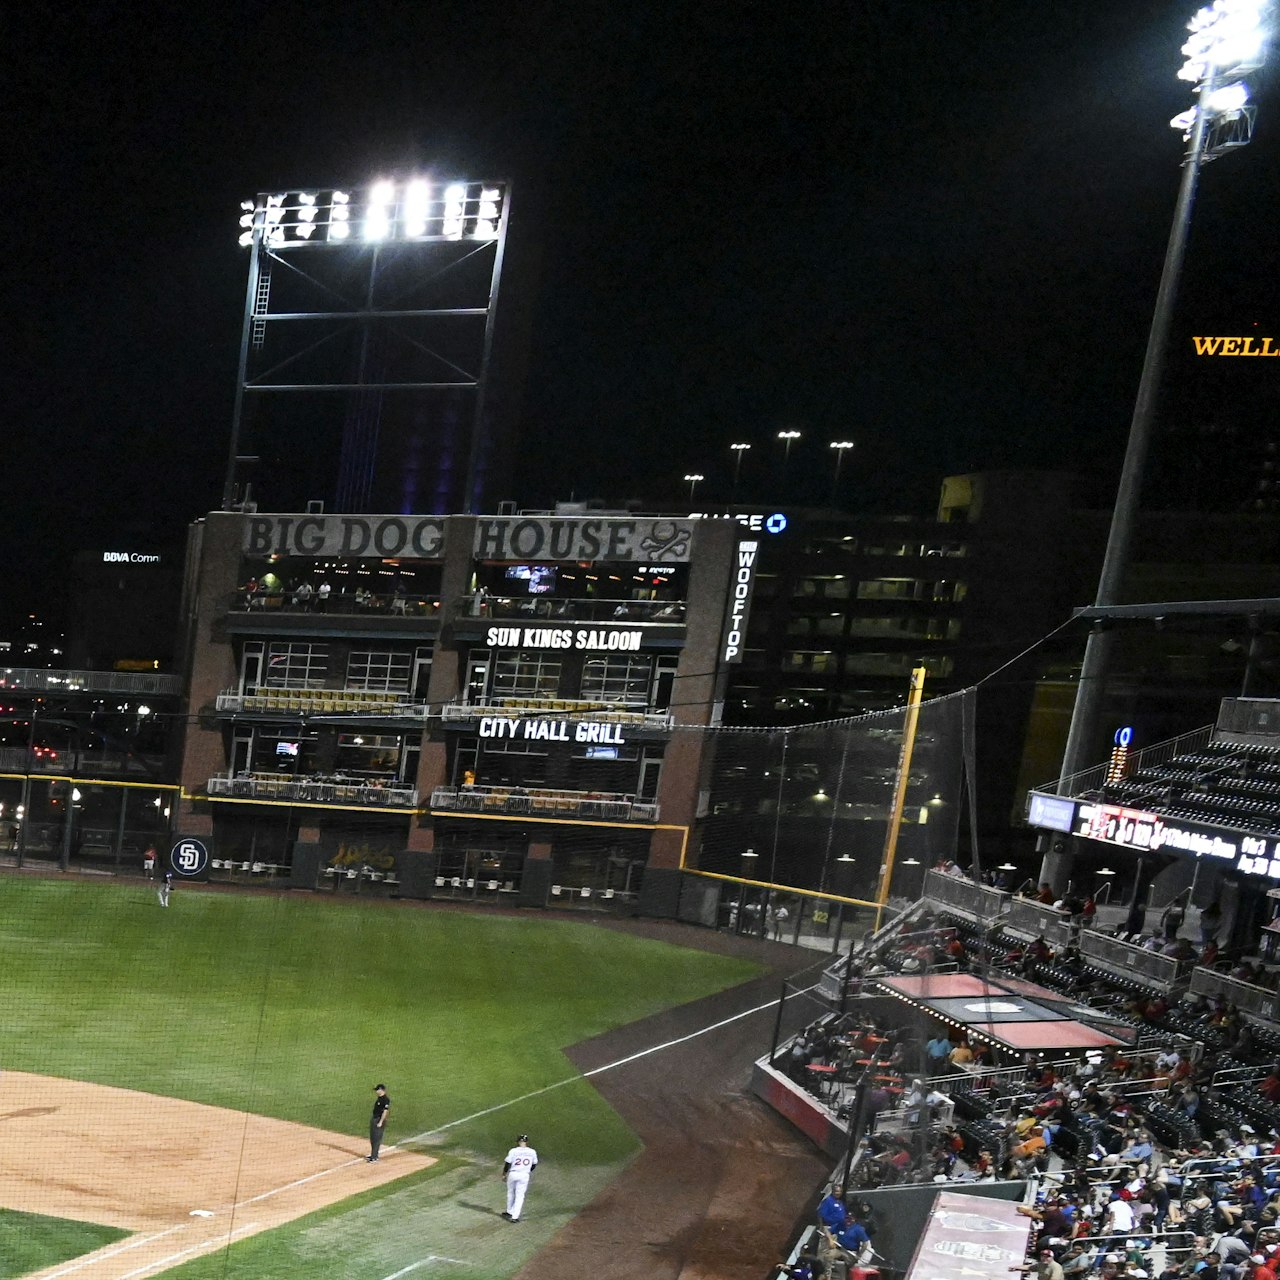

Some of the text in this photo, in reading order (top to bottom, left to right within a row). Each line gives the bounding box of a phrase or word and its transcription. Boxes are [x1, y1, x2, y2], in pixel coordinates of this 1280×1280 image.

[1192, 336, 1280, 357] WELL
[248, 517, 635, 560] BIG DOG HOUSE
[103, 552, 130, 563] BBVA
[725, 552, 756, 661] WOOFTOP
[487, 627, 643, 651] SUN KINGS SALOON
[479, 717, 626, 745] CITY HALL GRILL
